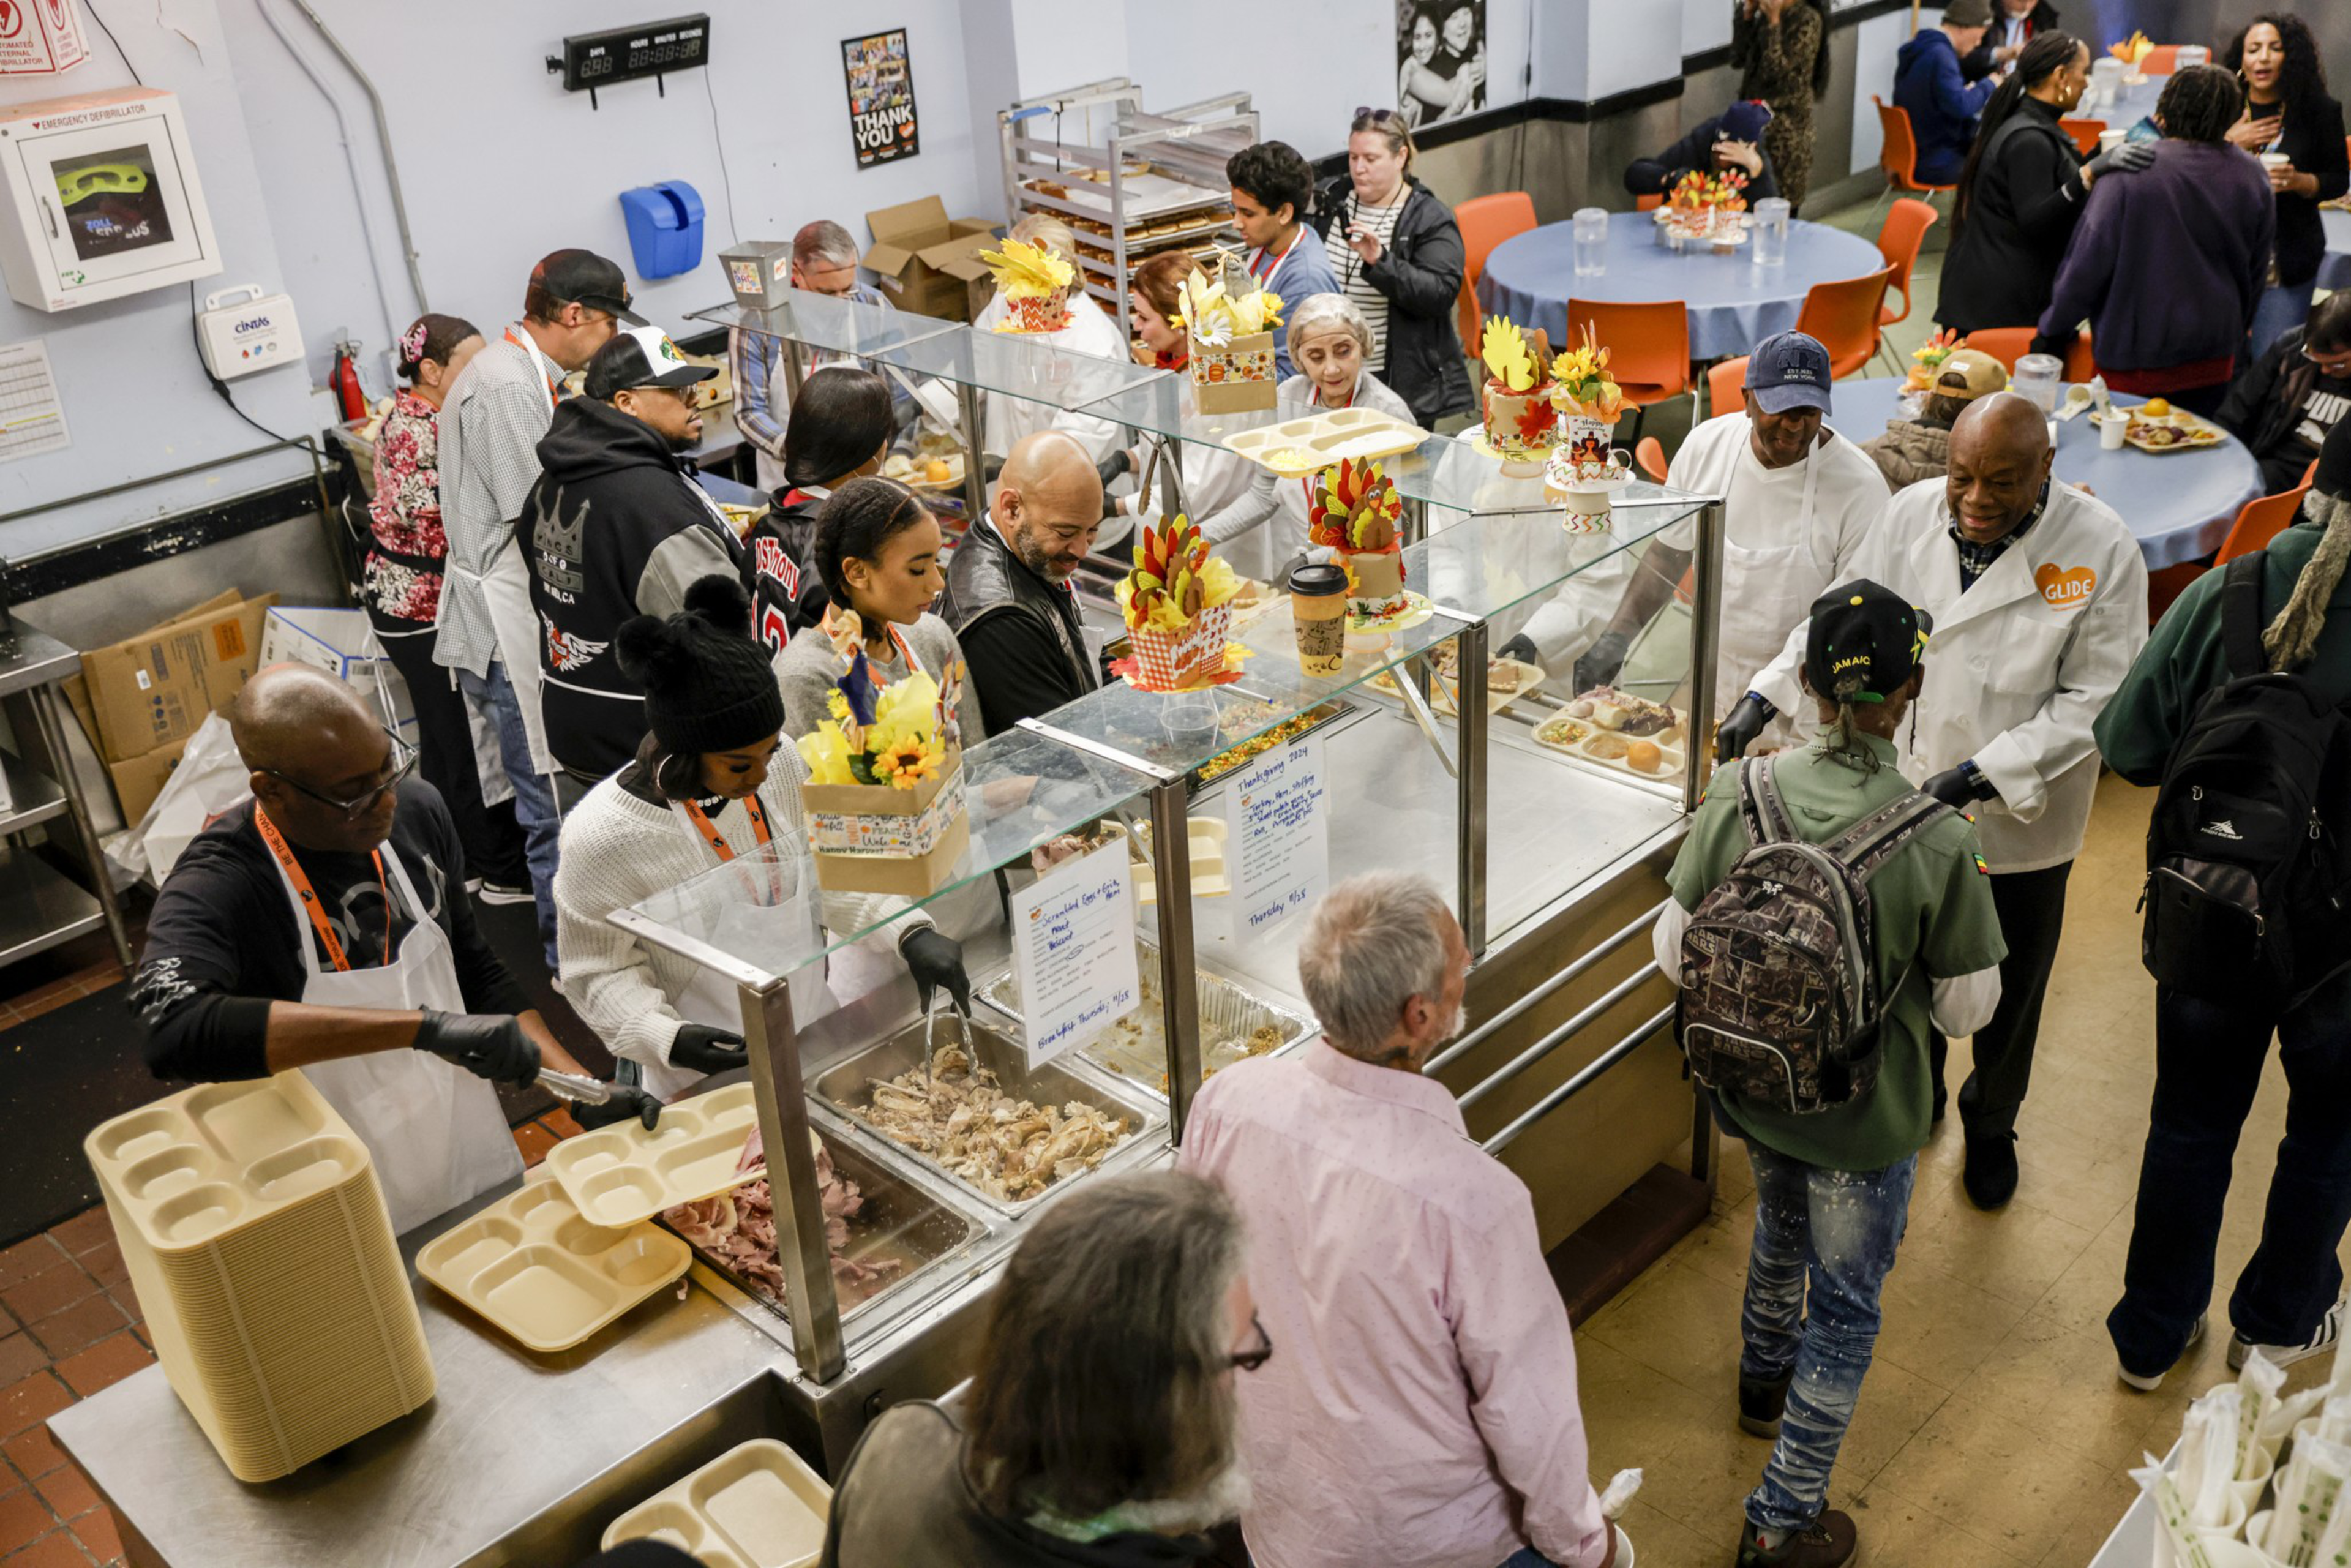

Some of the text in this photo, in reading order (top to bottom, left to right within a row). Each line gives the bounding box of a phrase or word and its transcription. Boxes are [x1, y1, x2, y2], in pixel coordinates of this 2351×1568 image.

[42, 104, 146, 130] EMERGENCY DEFIBRILLATOR
[853, 104, 913, 133] THANK
[856, 126, 894, 149] YOU
[86, 218, 113, 232] ZOLL
[2045, 579, 2092, 600] GLIDE
[1832, 655, 1871, 674] JAMAIC
[1238, 758, 1284, 792] Thanksgiving
[1289, 746, 1308, 763] 2024
[271, 836, 285, 853] THE
[282, 853, 293, 865] BE
[1042, 898, 1079, 928] Scrambled
[1082, 892, 1096, 906] Eggs
[1249, 888, 1307, 927] Thursday 11/28
[1047, 929, 1073, 950] Biscuit
[1038, 1021, 1076, 1050] Breakfast
[1112, 990, 1130, 1007] 11/28
